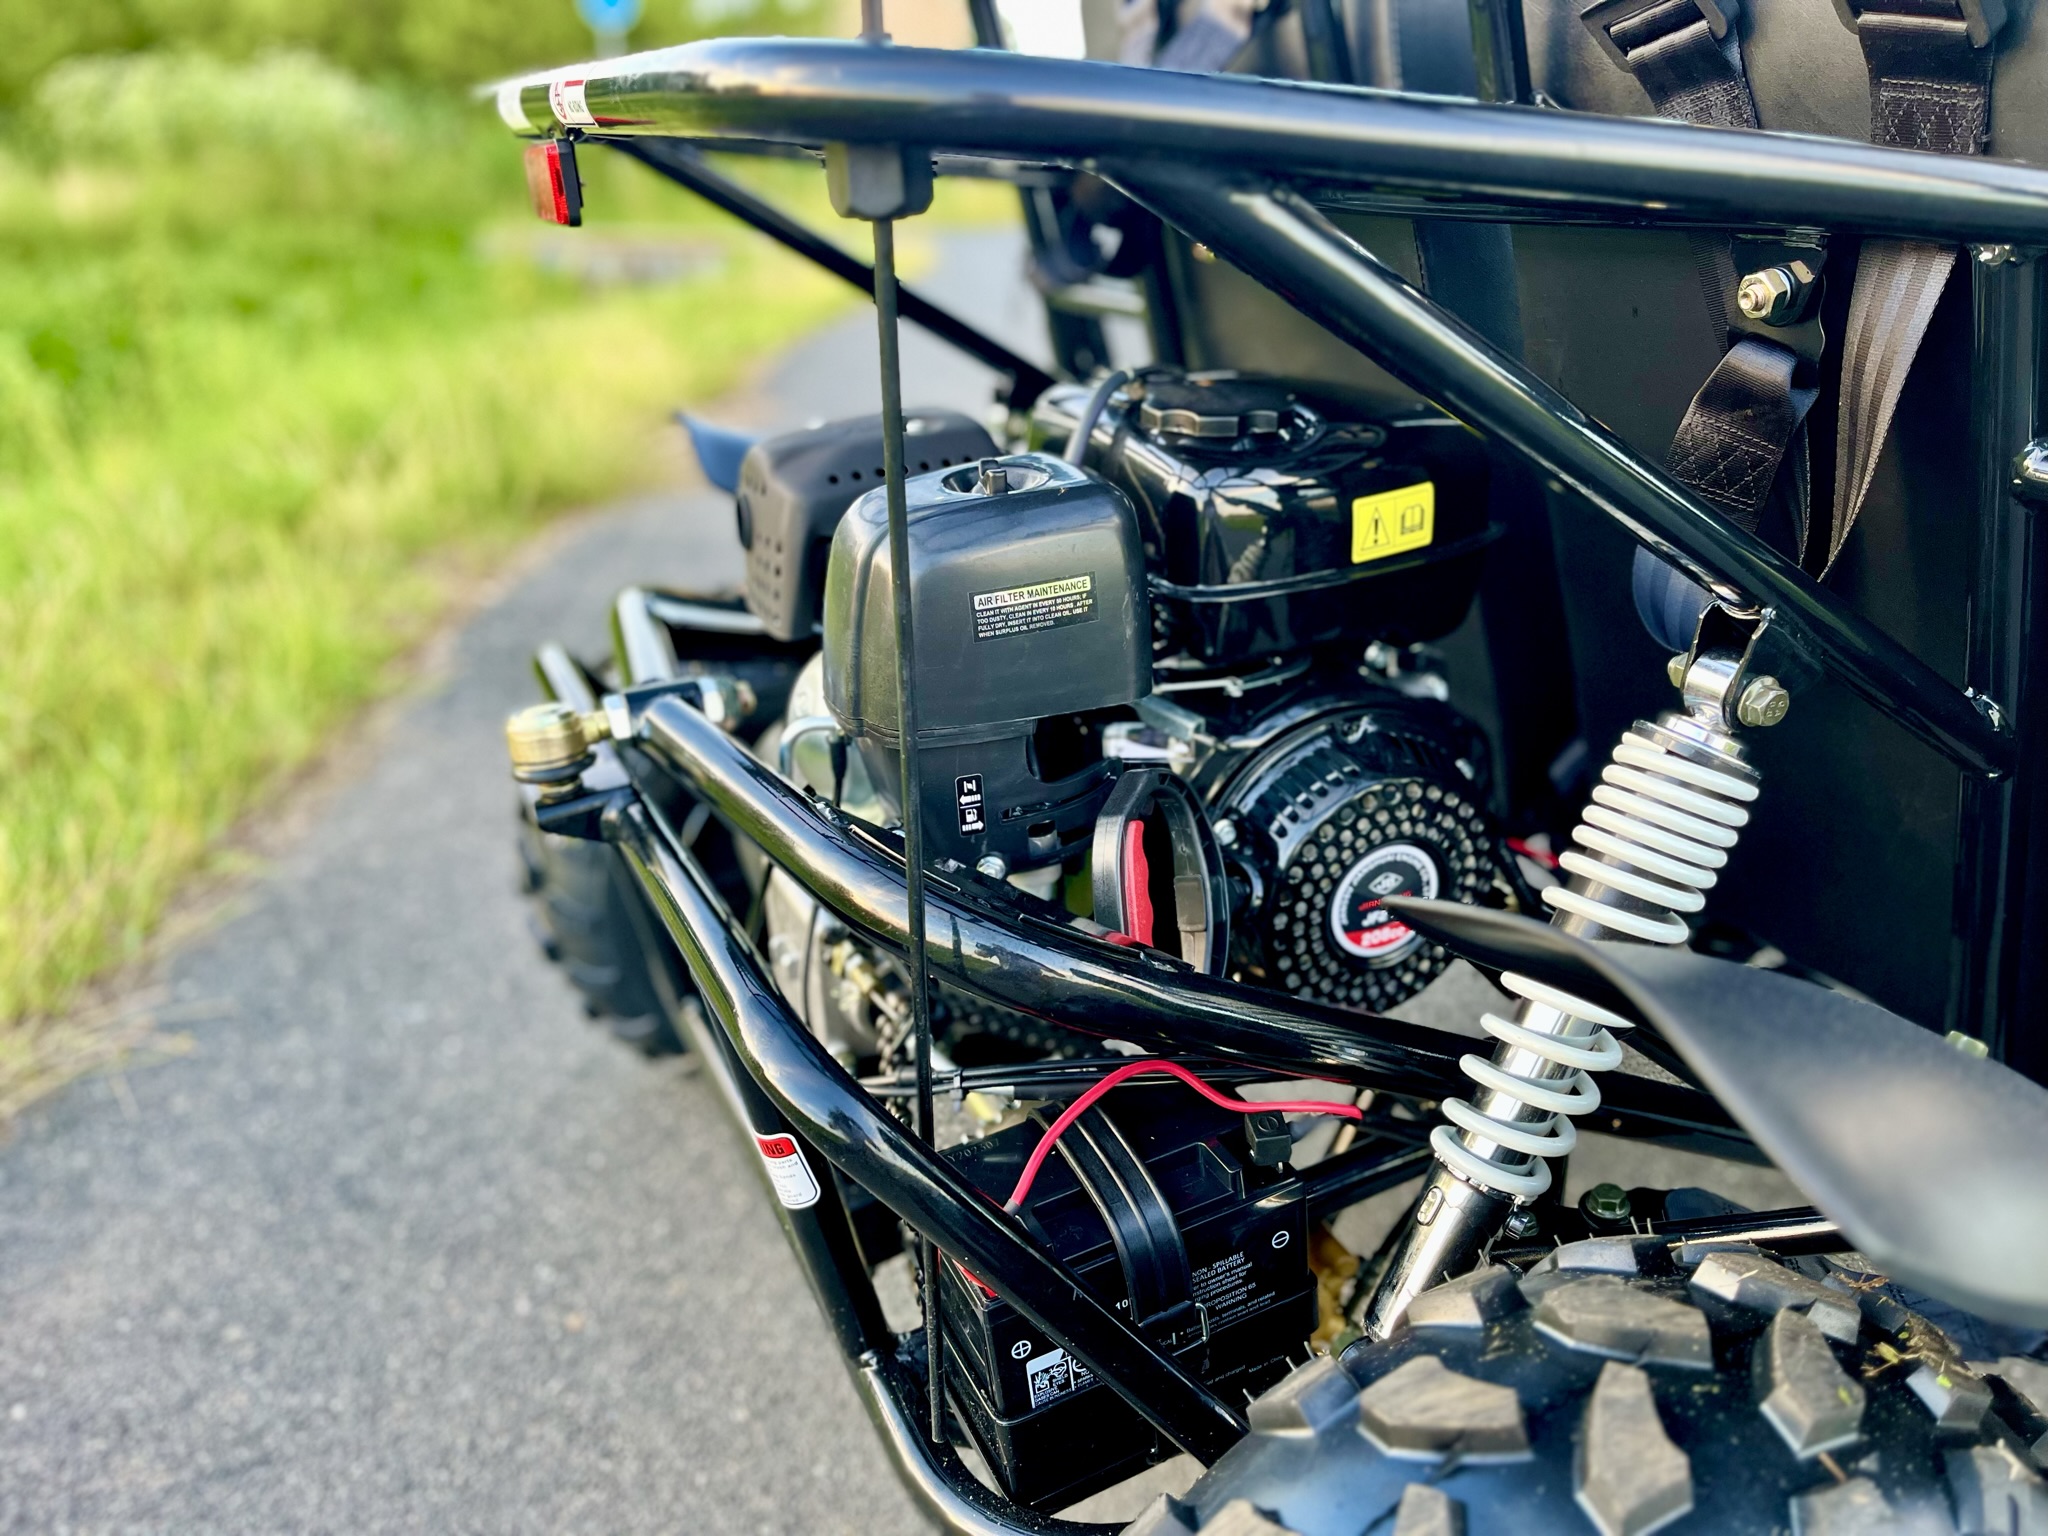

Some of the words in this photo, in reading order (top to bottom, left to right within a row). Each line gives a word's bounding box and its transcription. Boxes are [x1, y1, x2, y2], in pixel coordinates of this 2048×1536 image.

[978, 596, 993, 607] AIR
[995, 590, 1025, 605] FILTER
[1027, 579, 1088, 599] MAINTENANCE
[976, 610, 994, 618] CLEAN
[1001, 606, 1014, 614] WITH
[1015, 604, 1031, 612] AGENT
[1039, 599, 1055, 608] EVERY
[1033, 607, 1049, 615] EVERY
[1077, 599, 1093, 607] AFTER
[996, 627, 1019, 635] SURPLUS
[1192, 1267, 1207, 1278] NON
[1212, 1251, 1244, 1269] SPILLABLE
[1192, 1270, 1216, 1284] SEALED
[1217, 1257, 1245, 1274] BATTERY
[1207, 1272, 1230, 1284] owner's
[1231, 1261, 1253, 1275] manual
[1215, 1292, 1247, 1310] WARNING
[1247, 1298, 1257, 1307] and
[1258, 1291, 1276, 1302] related
